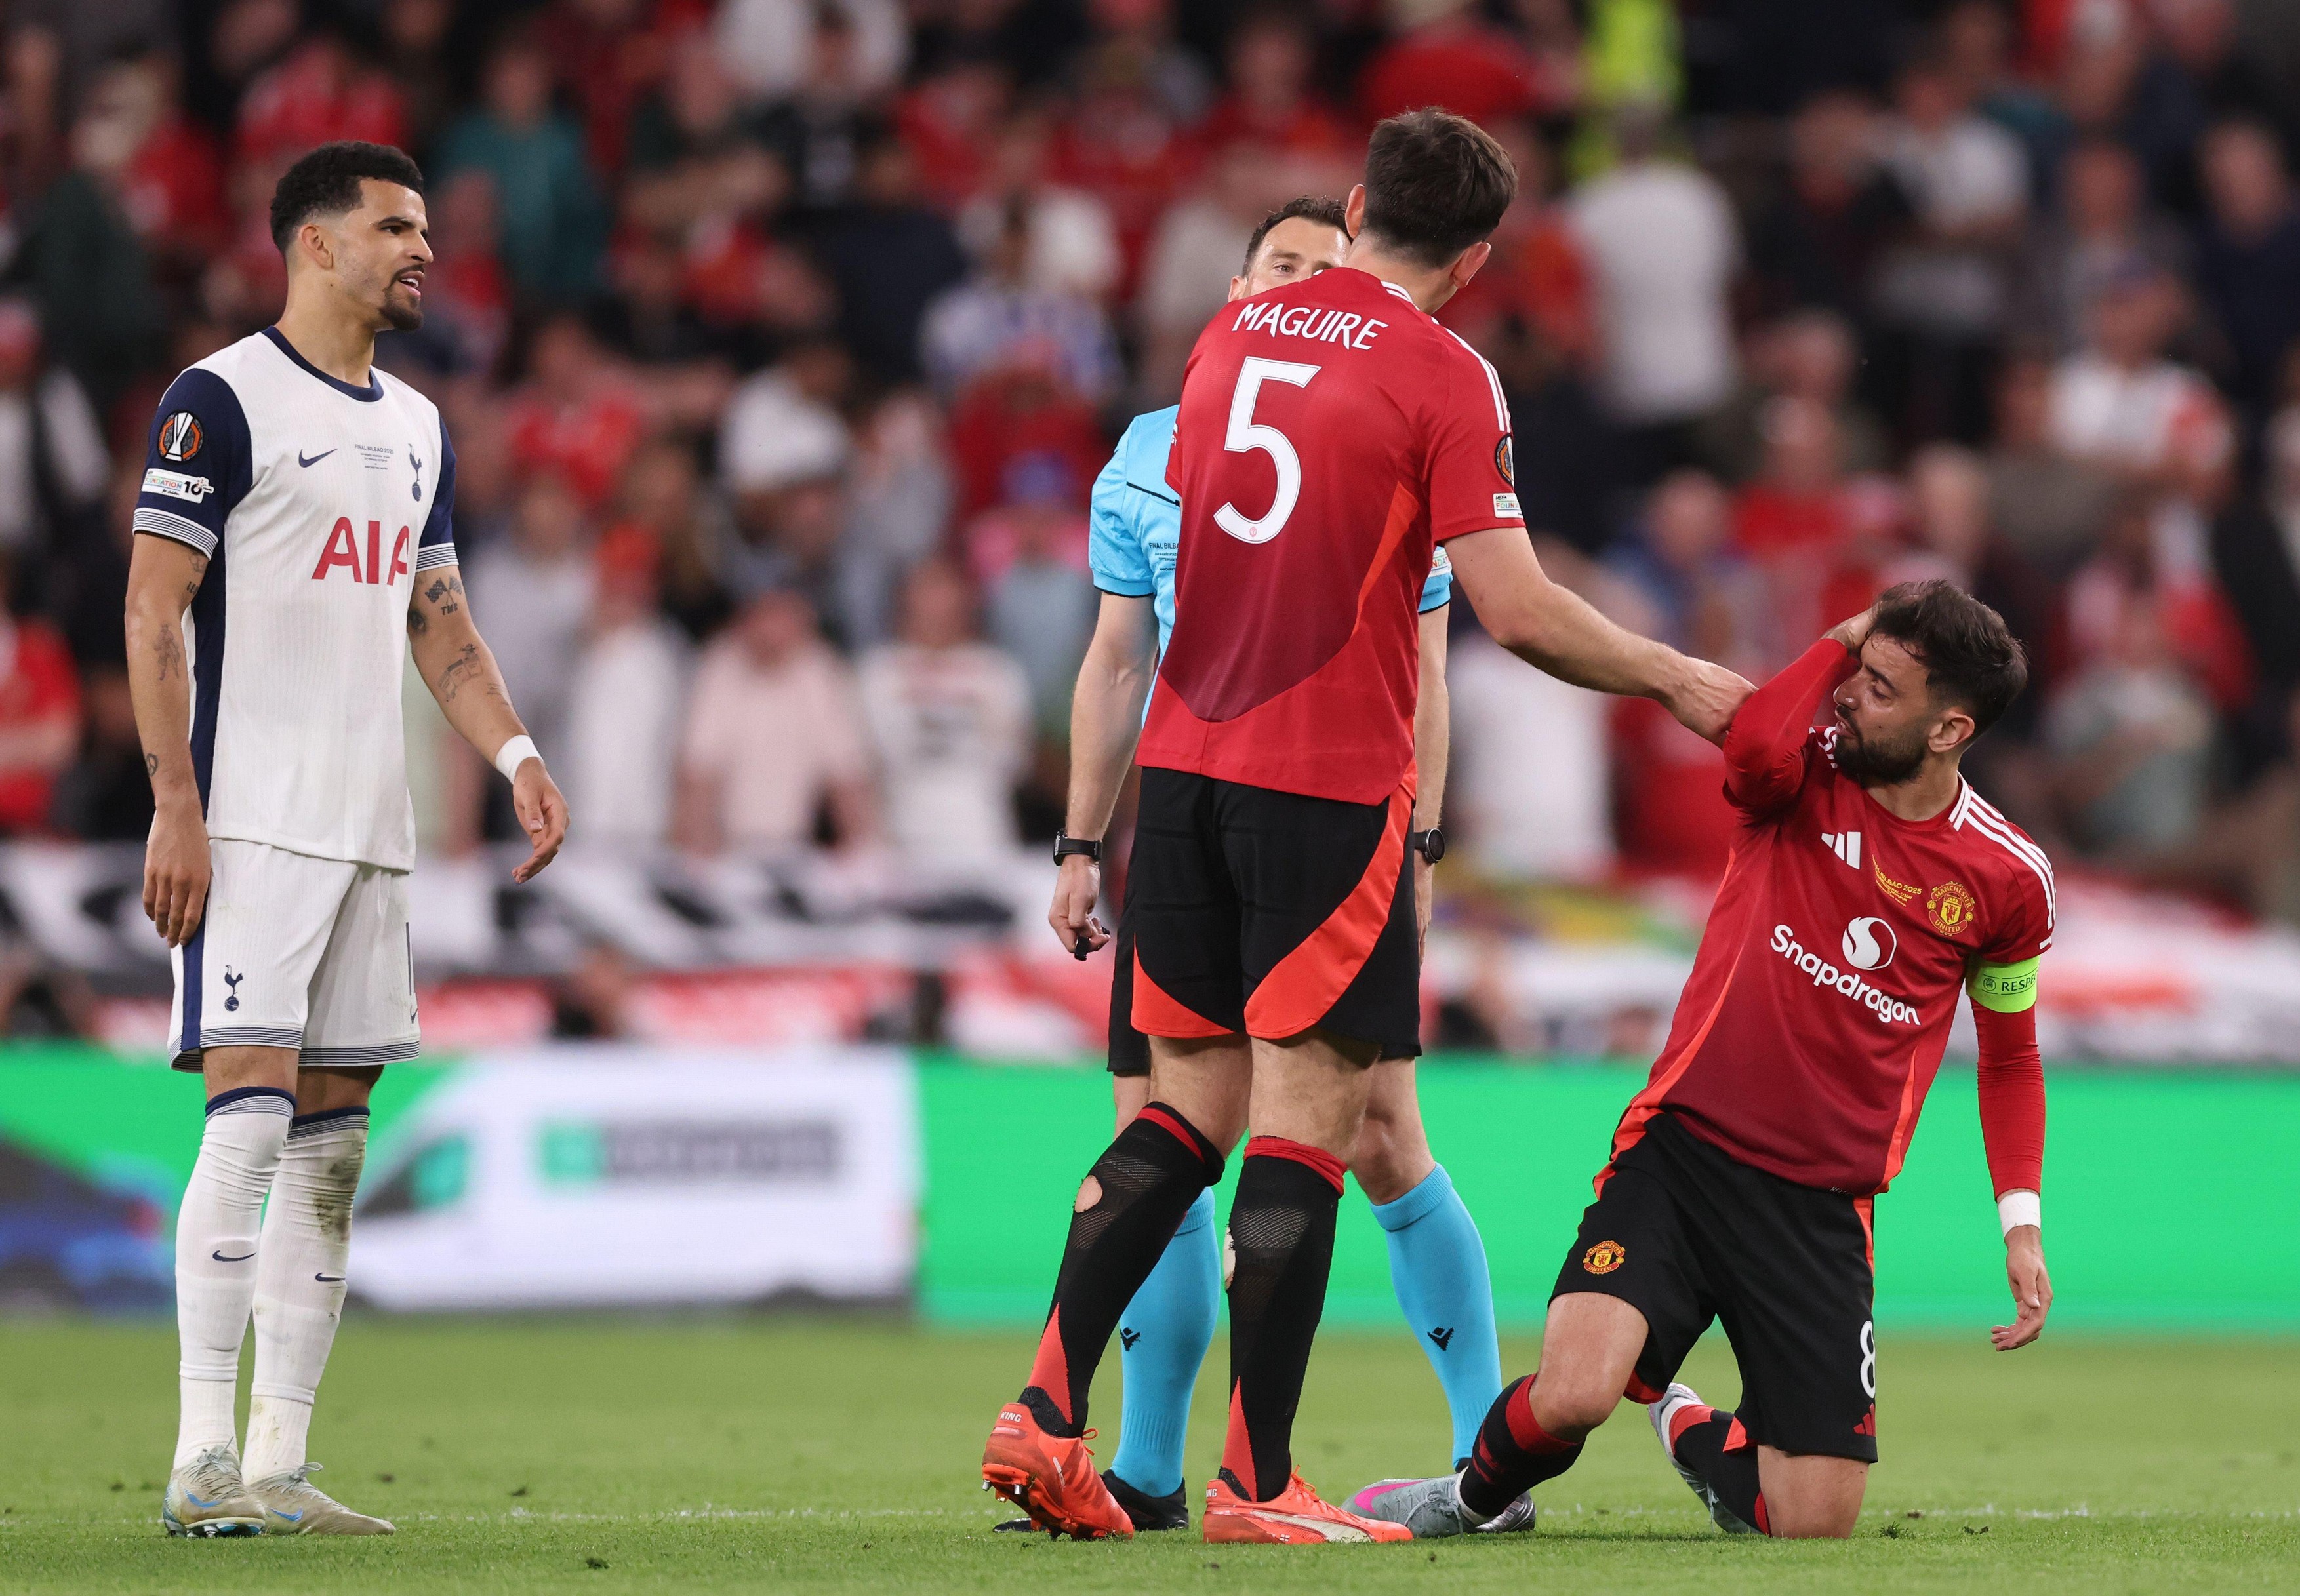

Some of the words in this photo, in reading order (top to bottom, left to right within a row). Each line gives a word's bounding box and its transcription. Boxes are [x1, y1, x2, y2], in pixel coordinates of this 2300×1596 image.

[1232, 302, 1389, 350] MAGUIRE
[1213, 355, 1323, 545] 5
[311, 517, 410, 586] AIA
[1903, 885, 1922, 895] 2025
[1934, 885, 1971, 908] MANCHESTER
[1934, 919, 1960, 932] UNITED
[1771, 925, 1922, 1026] Snapdragon
[1589, 1243, 1622, 1255] MANCHESTER
[1860, 1320, 1876, 1399] 8
[999, 1411, 1022, 1422] KING
